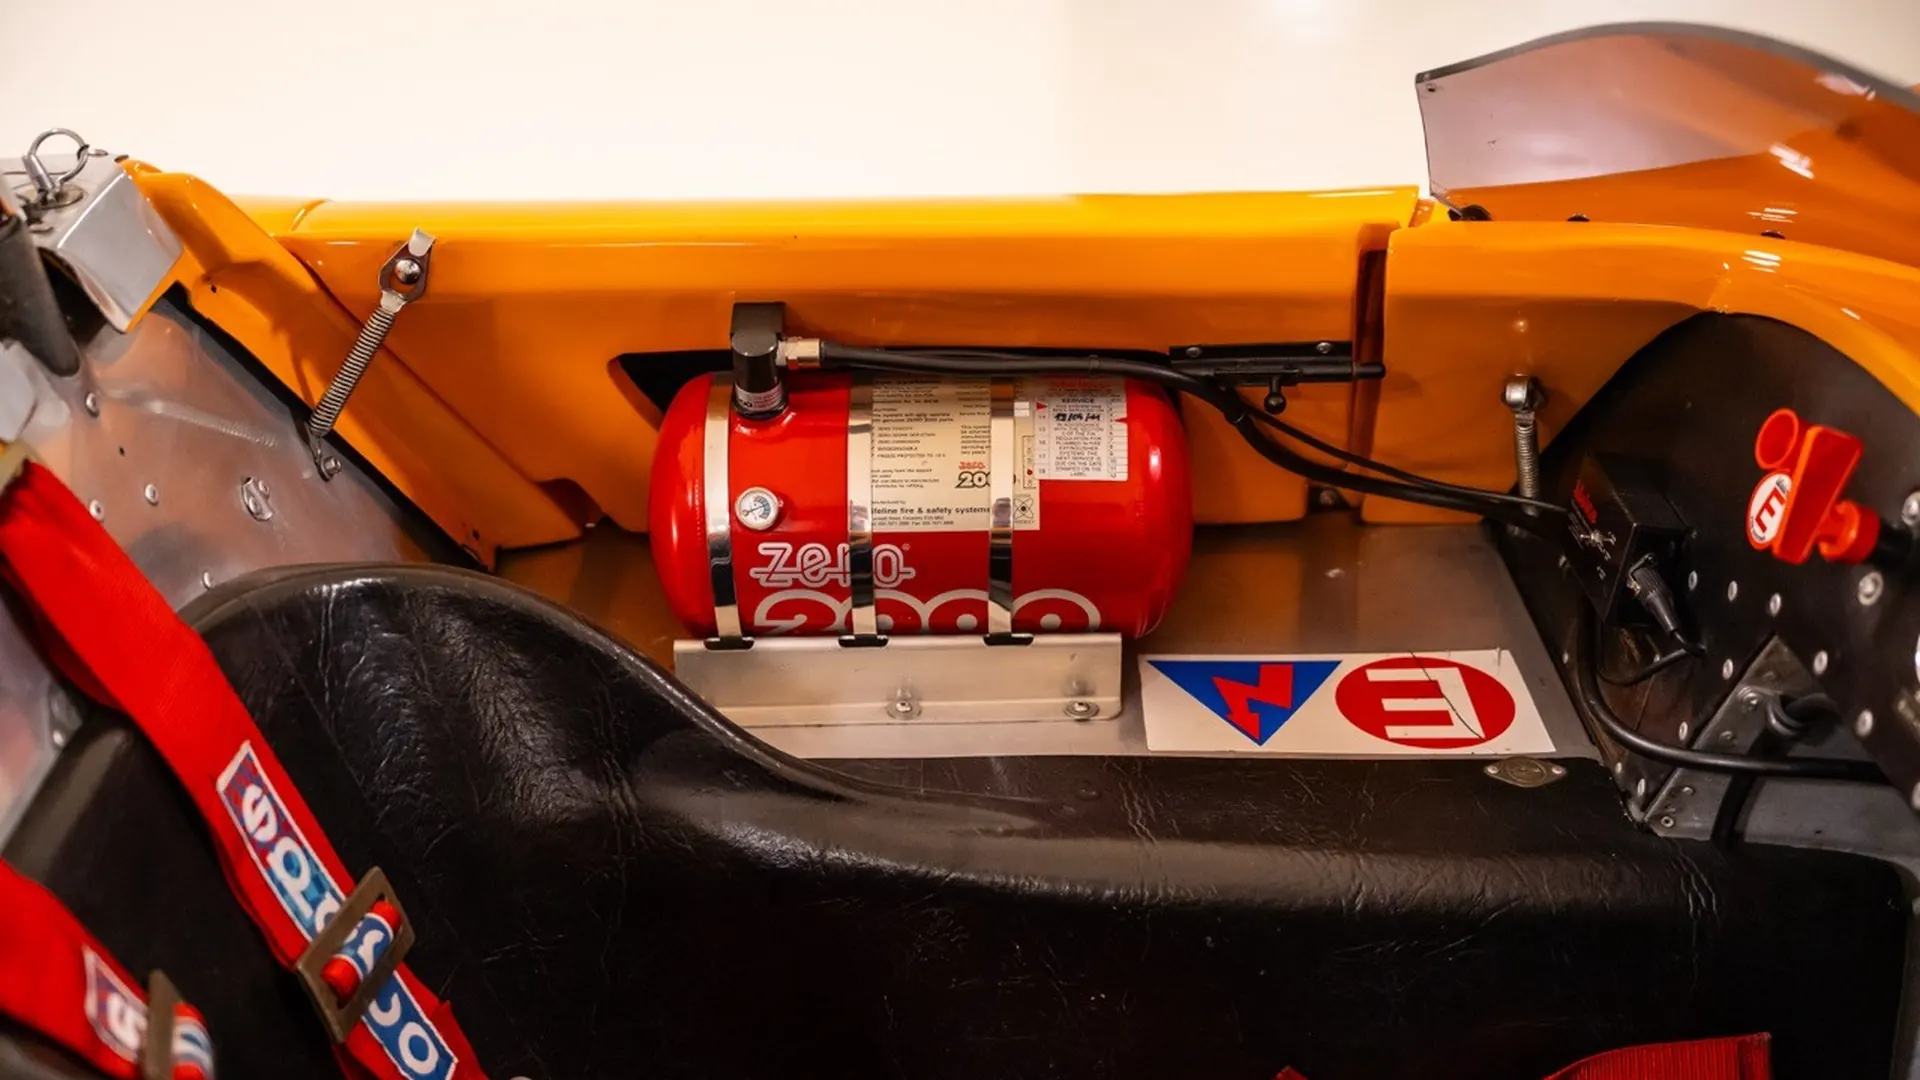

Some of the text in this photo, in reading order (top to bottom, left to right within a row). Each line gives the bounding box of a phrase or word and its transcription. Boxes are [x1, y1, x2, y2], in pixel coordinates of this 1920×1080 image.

[926, 507, 953, 516] safety
[1755, 487, 1786, 534] E
[750, 542, 917, 588] zero
